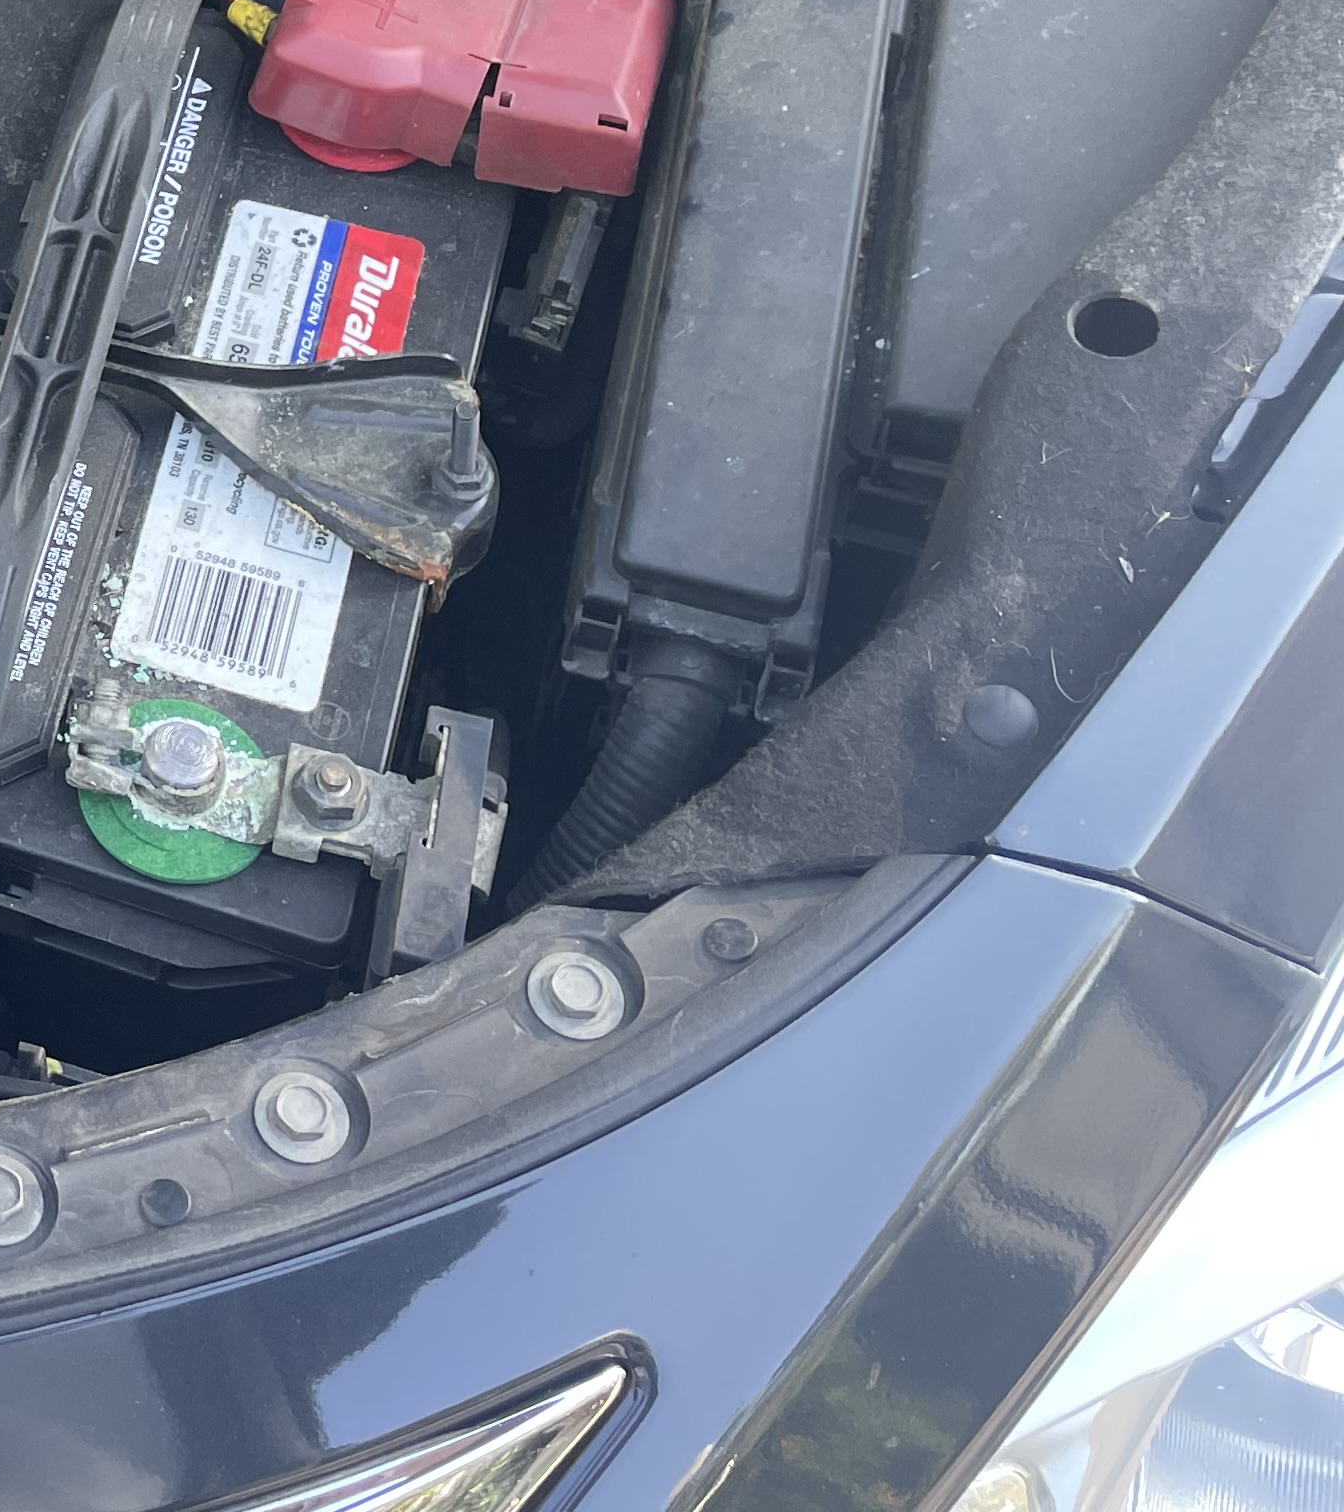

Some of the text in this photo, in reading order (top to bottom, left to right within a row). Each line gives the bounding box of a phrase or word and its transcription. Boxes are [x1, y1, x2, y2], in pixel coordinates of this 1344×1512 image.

[165, 94, 208, 177] DANGER
[137, 188, 179, 267] POISON
[217, 253, 240, 307] DISTRIBUTED
[247, 244, 271, 293] 24F-DL
[268, 249, 308, 365] Return used batteries to
[306, 259, 334, 326] PROVEN
[213, 305, 225, 319] BY
[206, 319, 221, 341] BEST
[71, 461, 88, 478] DO
[65, 477, 83, 499] NOT
[182, 504, 199, 527] 130
[50, 519, 69, 546] KEEP
[42, 545, 61, 572] VENT
[194, 549, 237, 569] 52948
[239, 561, 282, 582] 59589
[26, 483, 94, 667] KEEP OUT OF THE REACH OF CHILDREN
[34, 571, 53, 599] CAPS
[24, 598, 44, 629] TIGHT
[17, 628, 35, 652] AND
[8, 651, 28, 683] LEVEL
[159, 641, 210, 664] 52948
[216, 656, 267, 679] 59589
